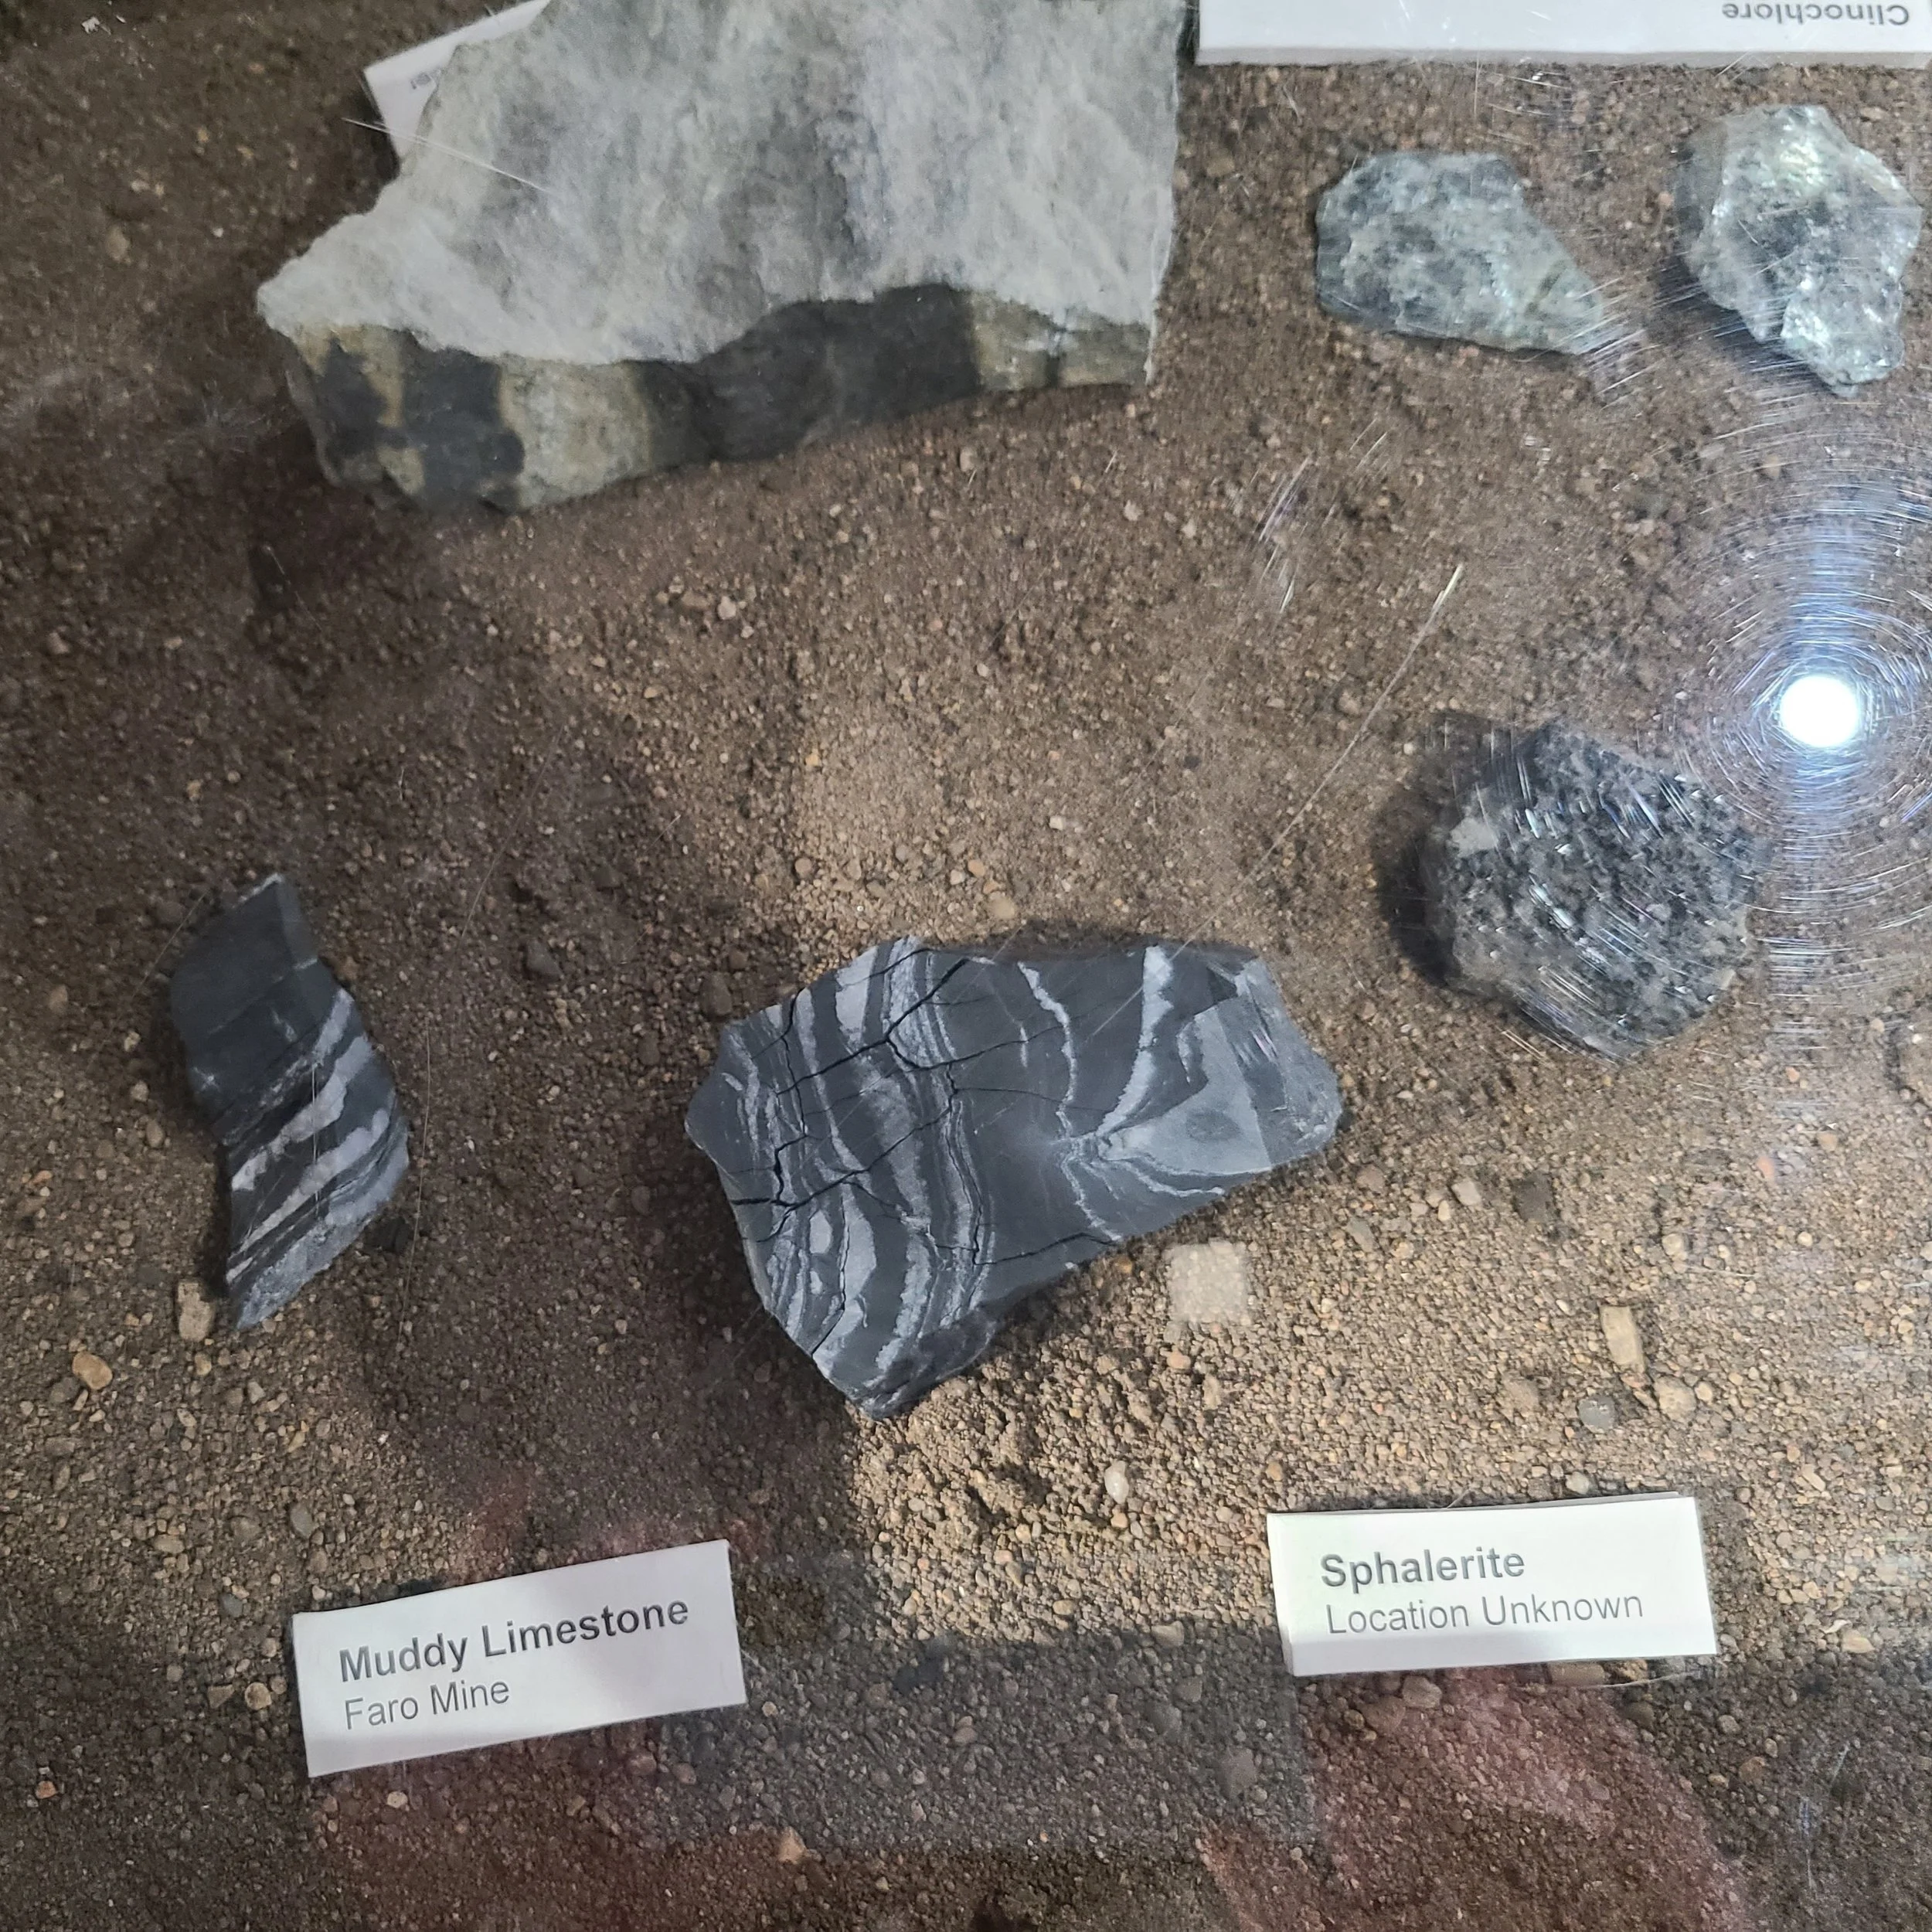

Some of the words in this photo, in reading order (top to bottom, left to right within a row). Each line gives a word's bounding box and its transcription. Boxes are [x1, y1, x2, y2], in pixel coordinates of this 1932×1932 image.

[1722, 2, 1910, 26] Clinochlore
[1320, 1546, 1526, 1594] Sphalerite
[1325, 1598, 1469, 1634] Location
[1481, 1594, 1644, 1626] Unknown
[339, 1632, 468, 1682] Muddy
[481, 1600, 689, 1658] Limestone
[345, 1694, 419, 1730] Faro
[430, 1679, 511, 1715] Mine
